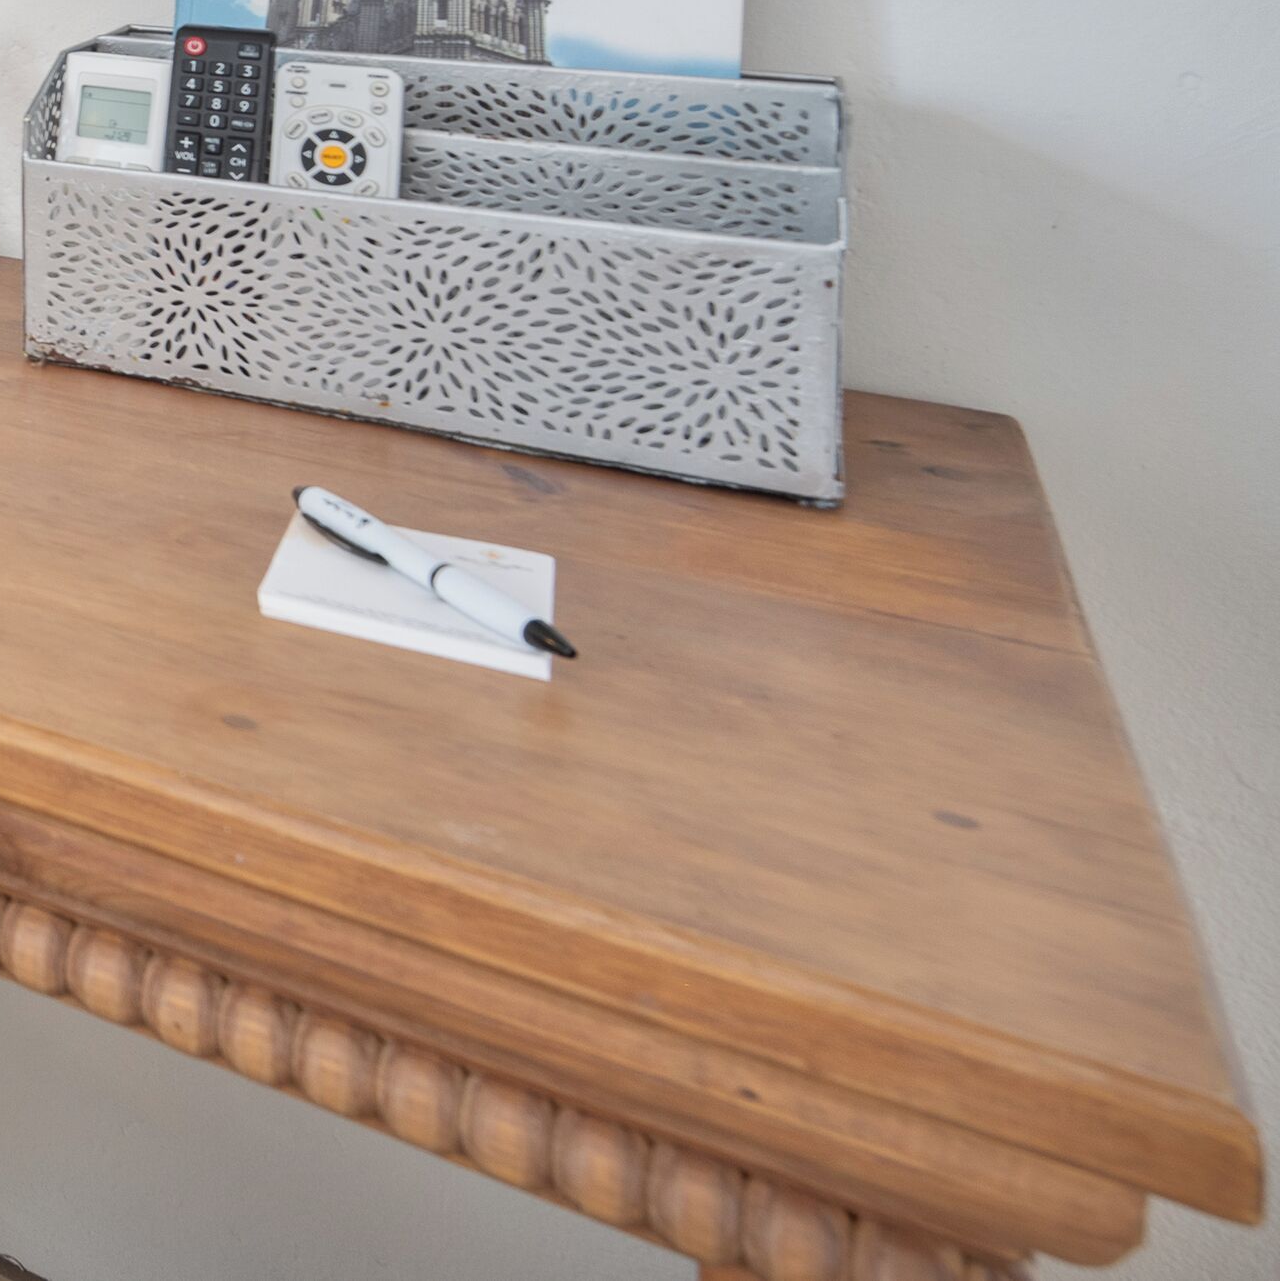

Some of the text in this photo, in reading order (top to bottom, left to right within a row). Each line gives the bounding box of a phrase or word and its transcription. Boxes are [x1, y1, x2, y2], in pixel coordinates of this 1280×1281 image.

[190, 61, 197, 72] 1
[215, 63, 225, 74] 2
[243, 65, 252, 77] 3
[186, 78, 196, 90] 4
[213, 81, 224, 92] 5
[241, 83, 251, 95] 6
[184, 95, 195, 106] 7
[211, 98, 222, 110] 8
[239, 101, 250, 112] 9
[175, 150, 196, 161] VOL
[230, 157, 246, 167] CH
